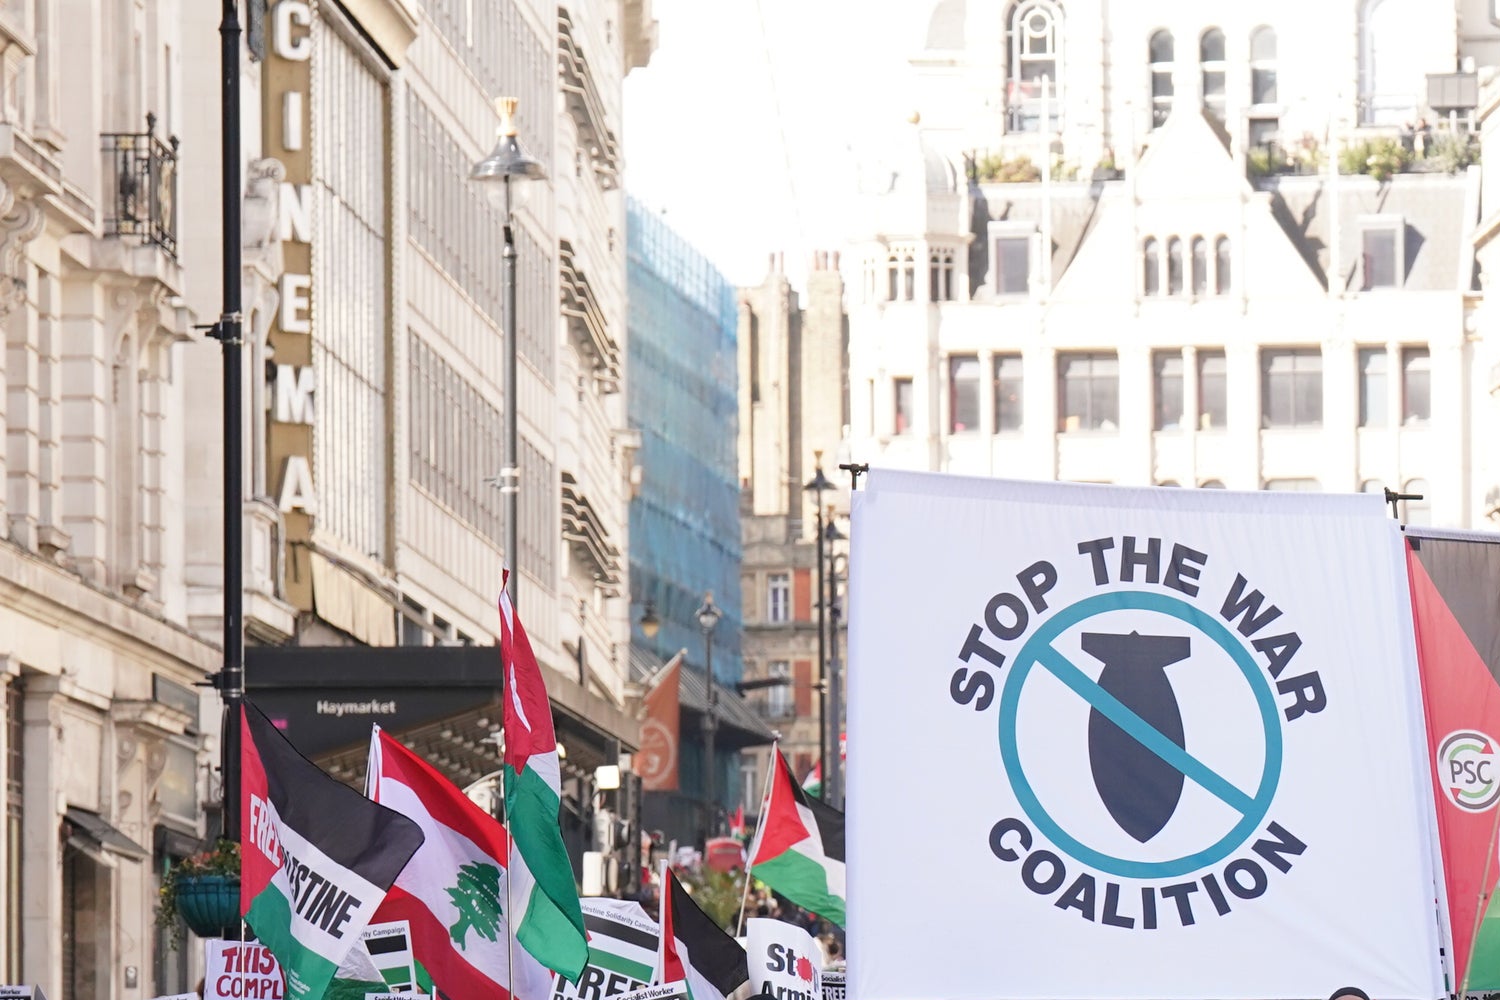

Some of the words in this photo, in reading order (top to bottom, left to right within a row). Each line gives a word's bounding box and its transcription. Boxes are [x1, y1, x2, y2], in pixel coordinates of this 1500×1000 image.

[271, 0, 315, 517] CINEMA
[950, 560, 1058, 711] STOP
[1078, 535, 1208, 598] THE
[1219, 572, 1328, 722] WAR
[317, 700, 397, 715] Haymarket
[1450, 760, 1493, 785] PSC
[249, 792, 283, 868] FREE
[988, 817, 1308, 930] COALITION
[605, 910, 635, 926] Solidarity
[373, 926, 406, 939] Campaign
[222, 946, 275, 975] THIS
[215, 974, 284, 1000] COMPL
[648, 987, 674, 998] Worker
